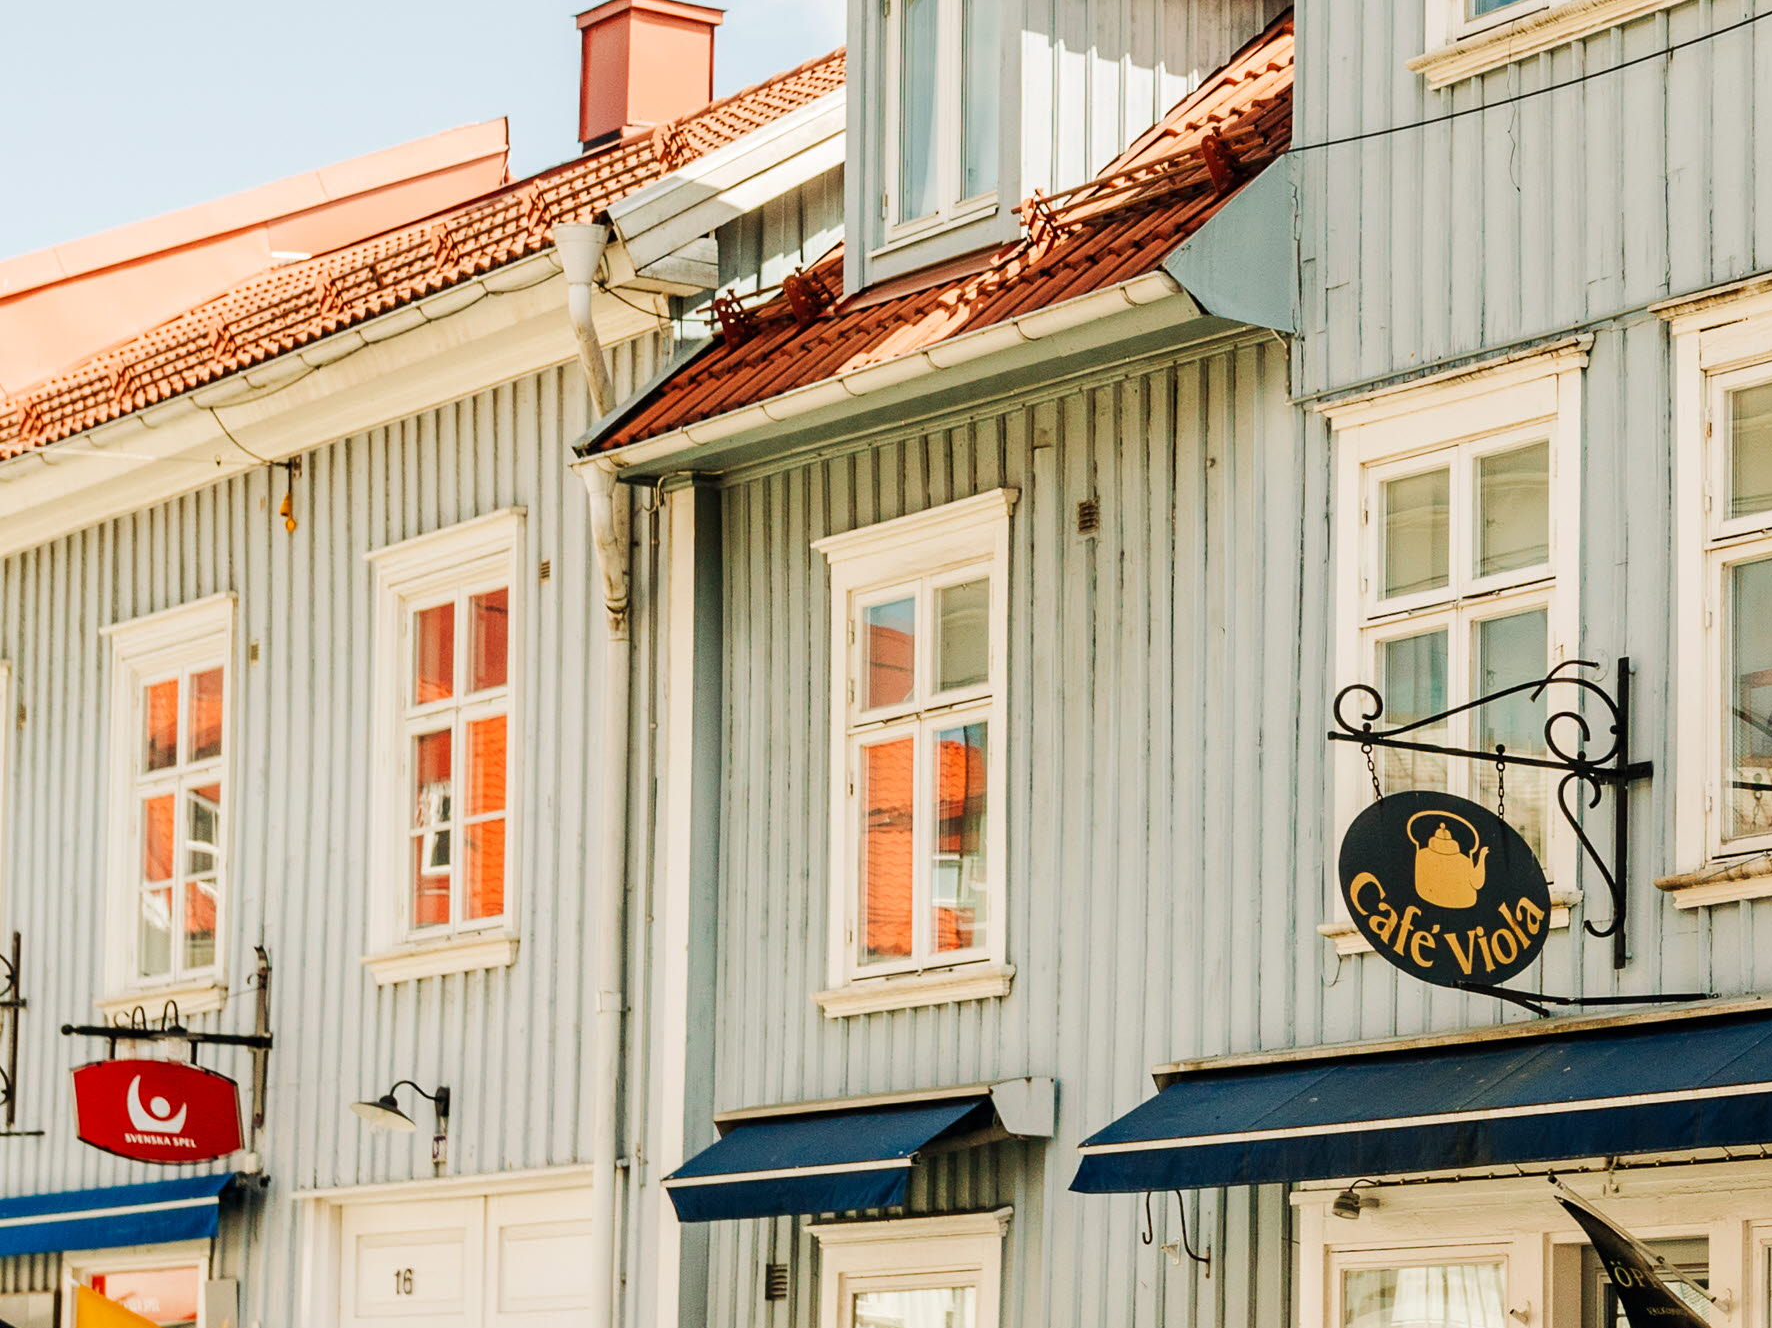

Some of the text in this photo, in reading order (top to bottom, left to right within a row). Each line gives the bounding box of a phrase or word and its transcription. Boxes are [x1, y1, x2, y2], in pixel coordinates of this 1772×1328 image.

[1350, 871, 1545, 975] Café Viola
[125, 1133, 197, 1148] SVENSKA SPEL
[395, 1268, 413, 1295] 16
